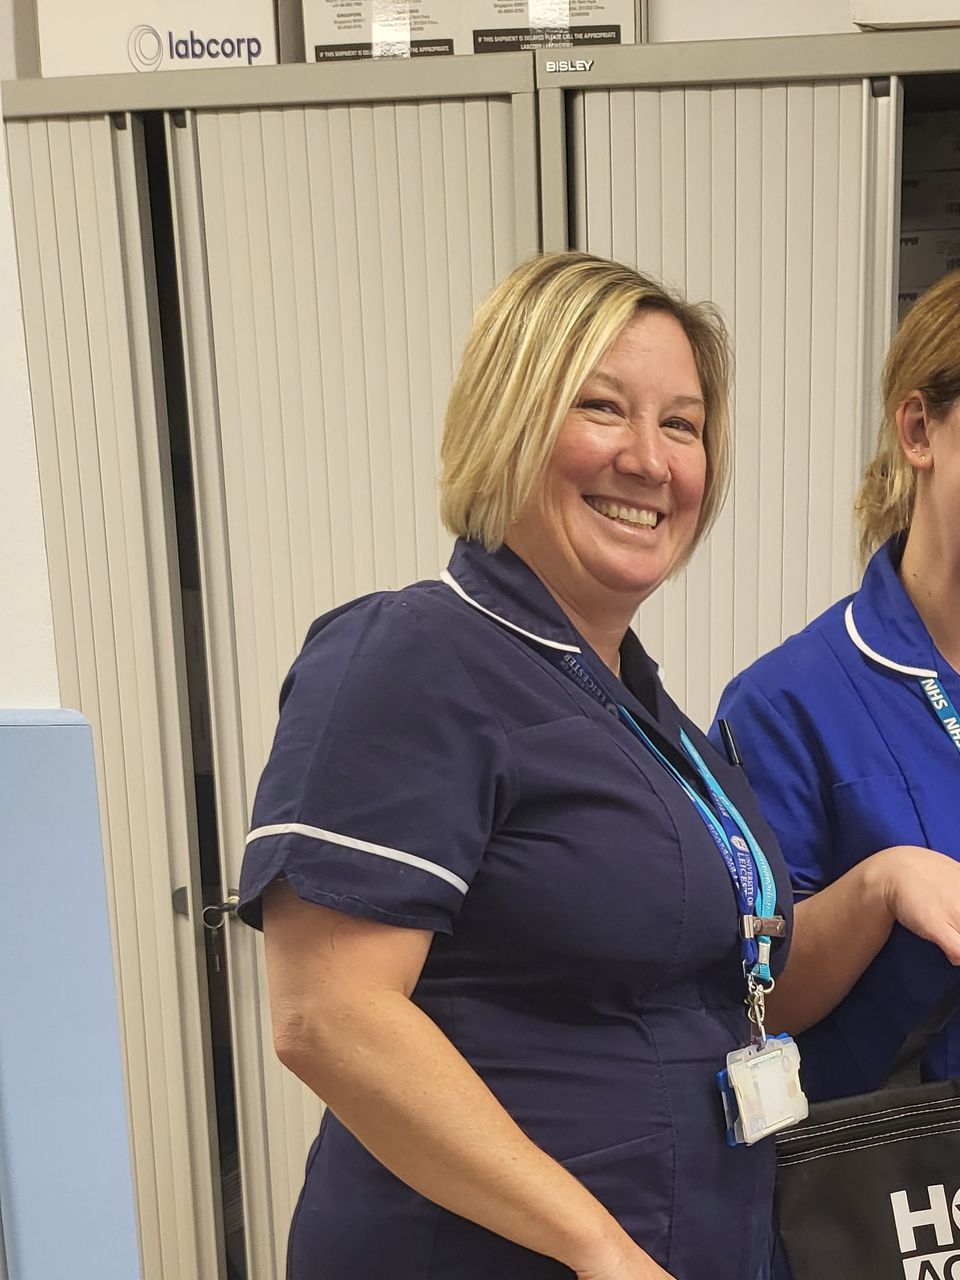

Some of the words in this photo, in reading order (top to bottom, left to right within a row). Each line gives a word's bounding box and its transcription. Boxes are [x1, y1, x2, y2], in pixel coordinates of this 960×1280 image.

[168, 30, 262, 65] labcorp
[546, 60, 594, 73] BISLEY
[921, 678, 948, 710] NHS
